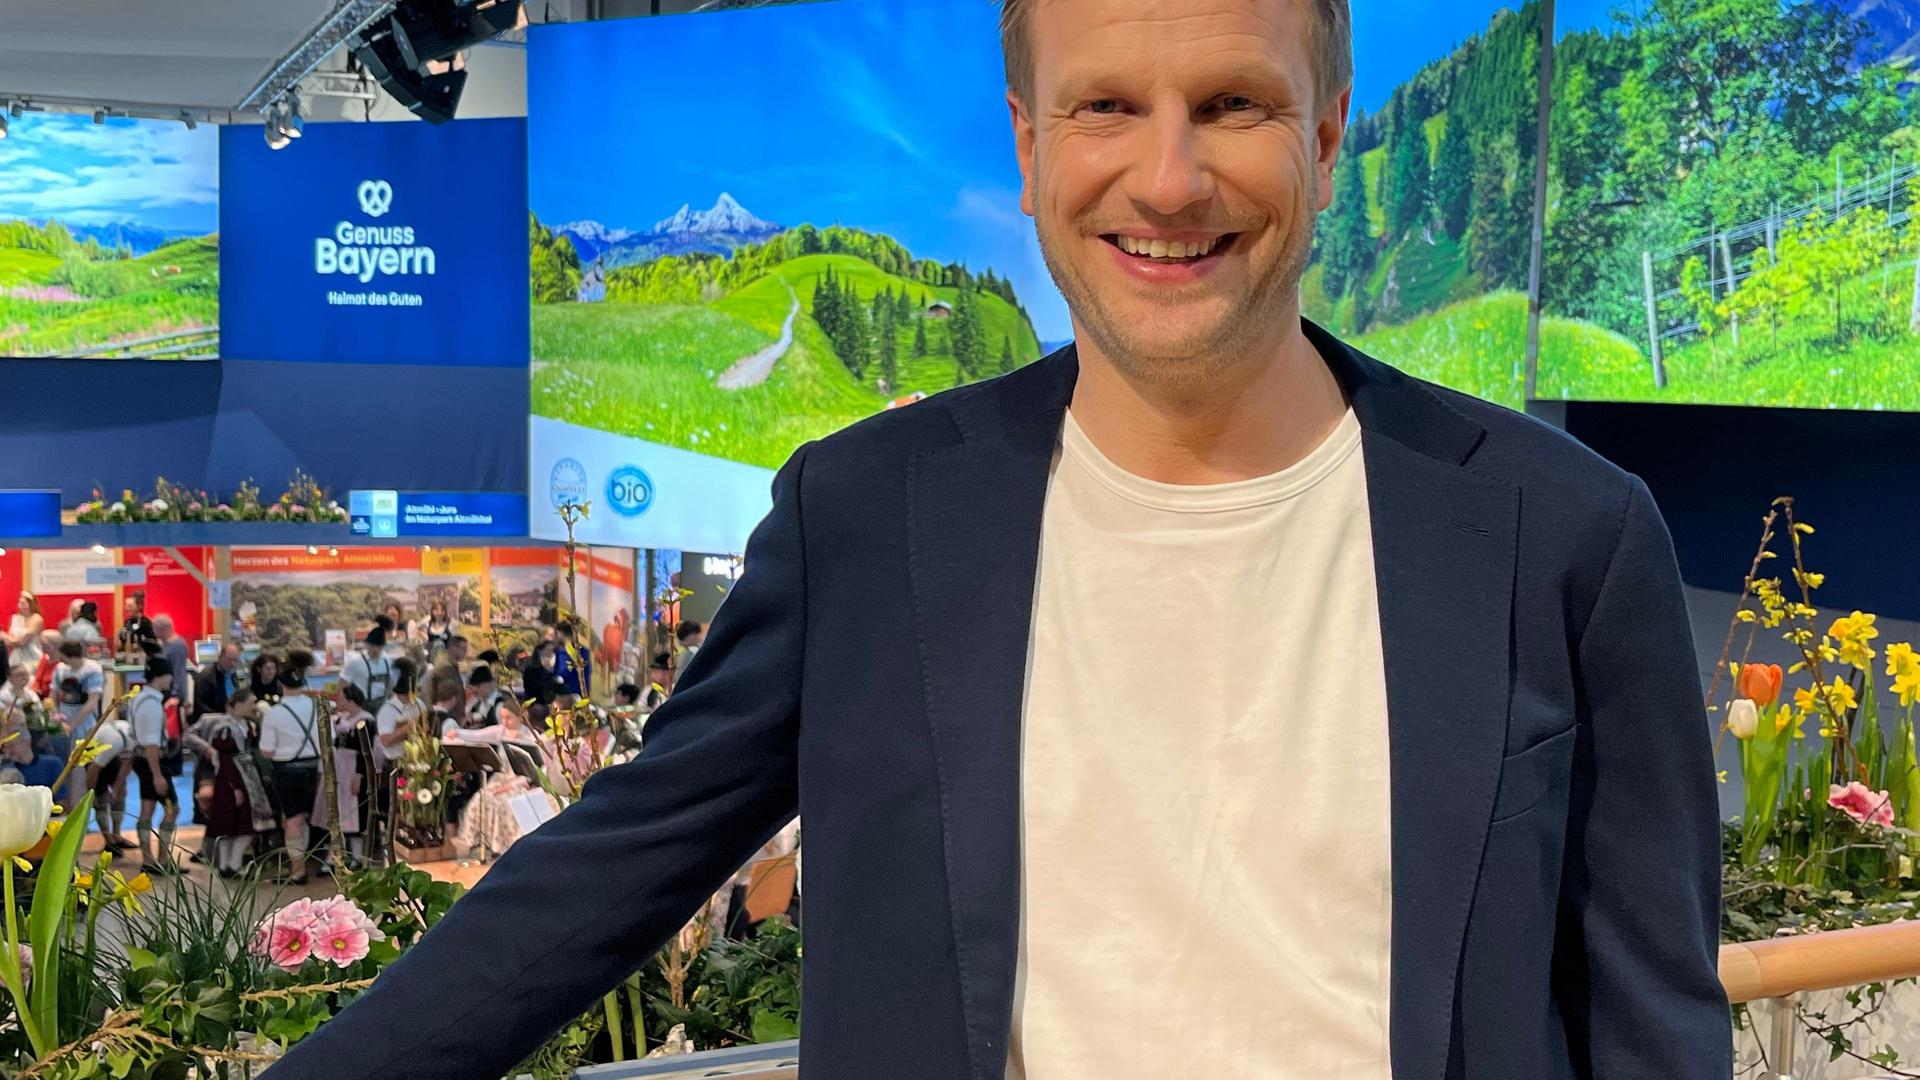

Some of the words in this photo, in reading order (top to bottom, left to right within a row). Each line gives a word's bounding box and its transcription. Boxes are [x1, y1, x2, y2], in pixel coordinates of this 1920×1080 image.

[336, 220, 415, 246] Genuss
[315, 237, 436, 283] Bayern
[328, 291, 367, 305] Heimat
[368, 291, 388, 306] des
[389, 291, 422, 306] Guten
